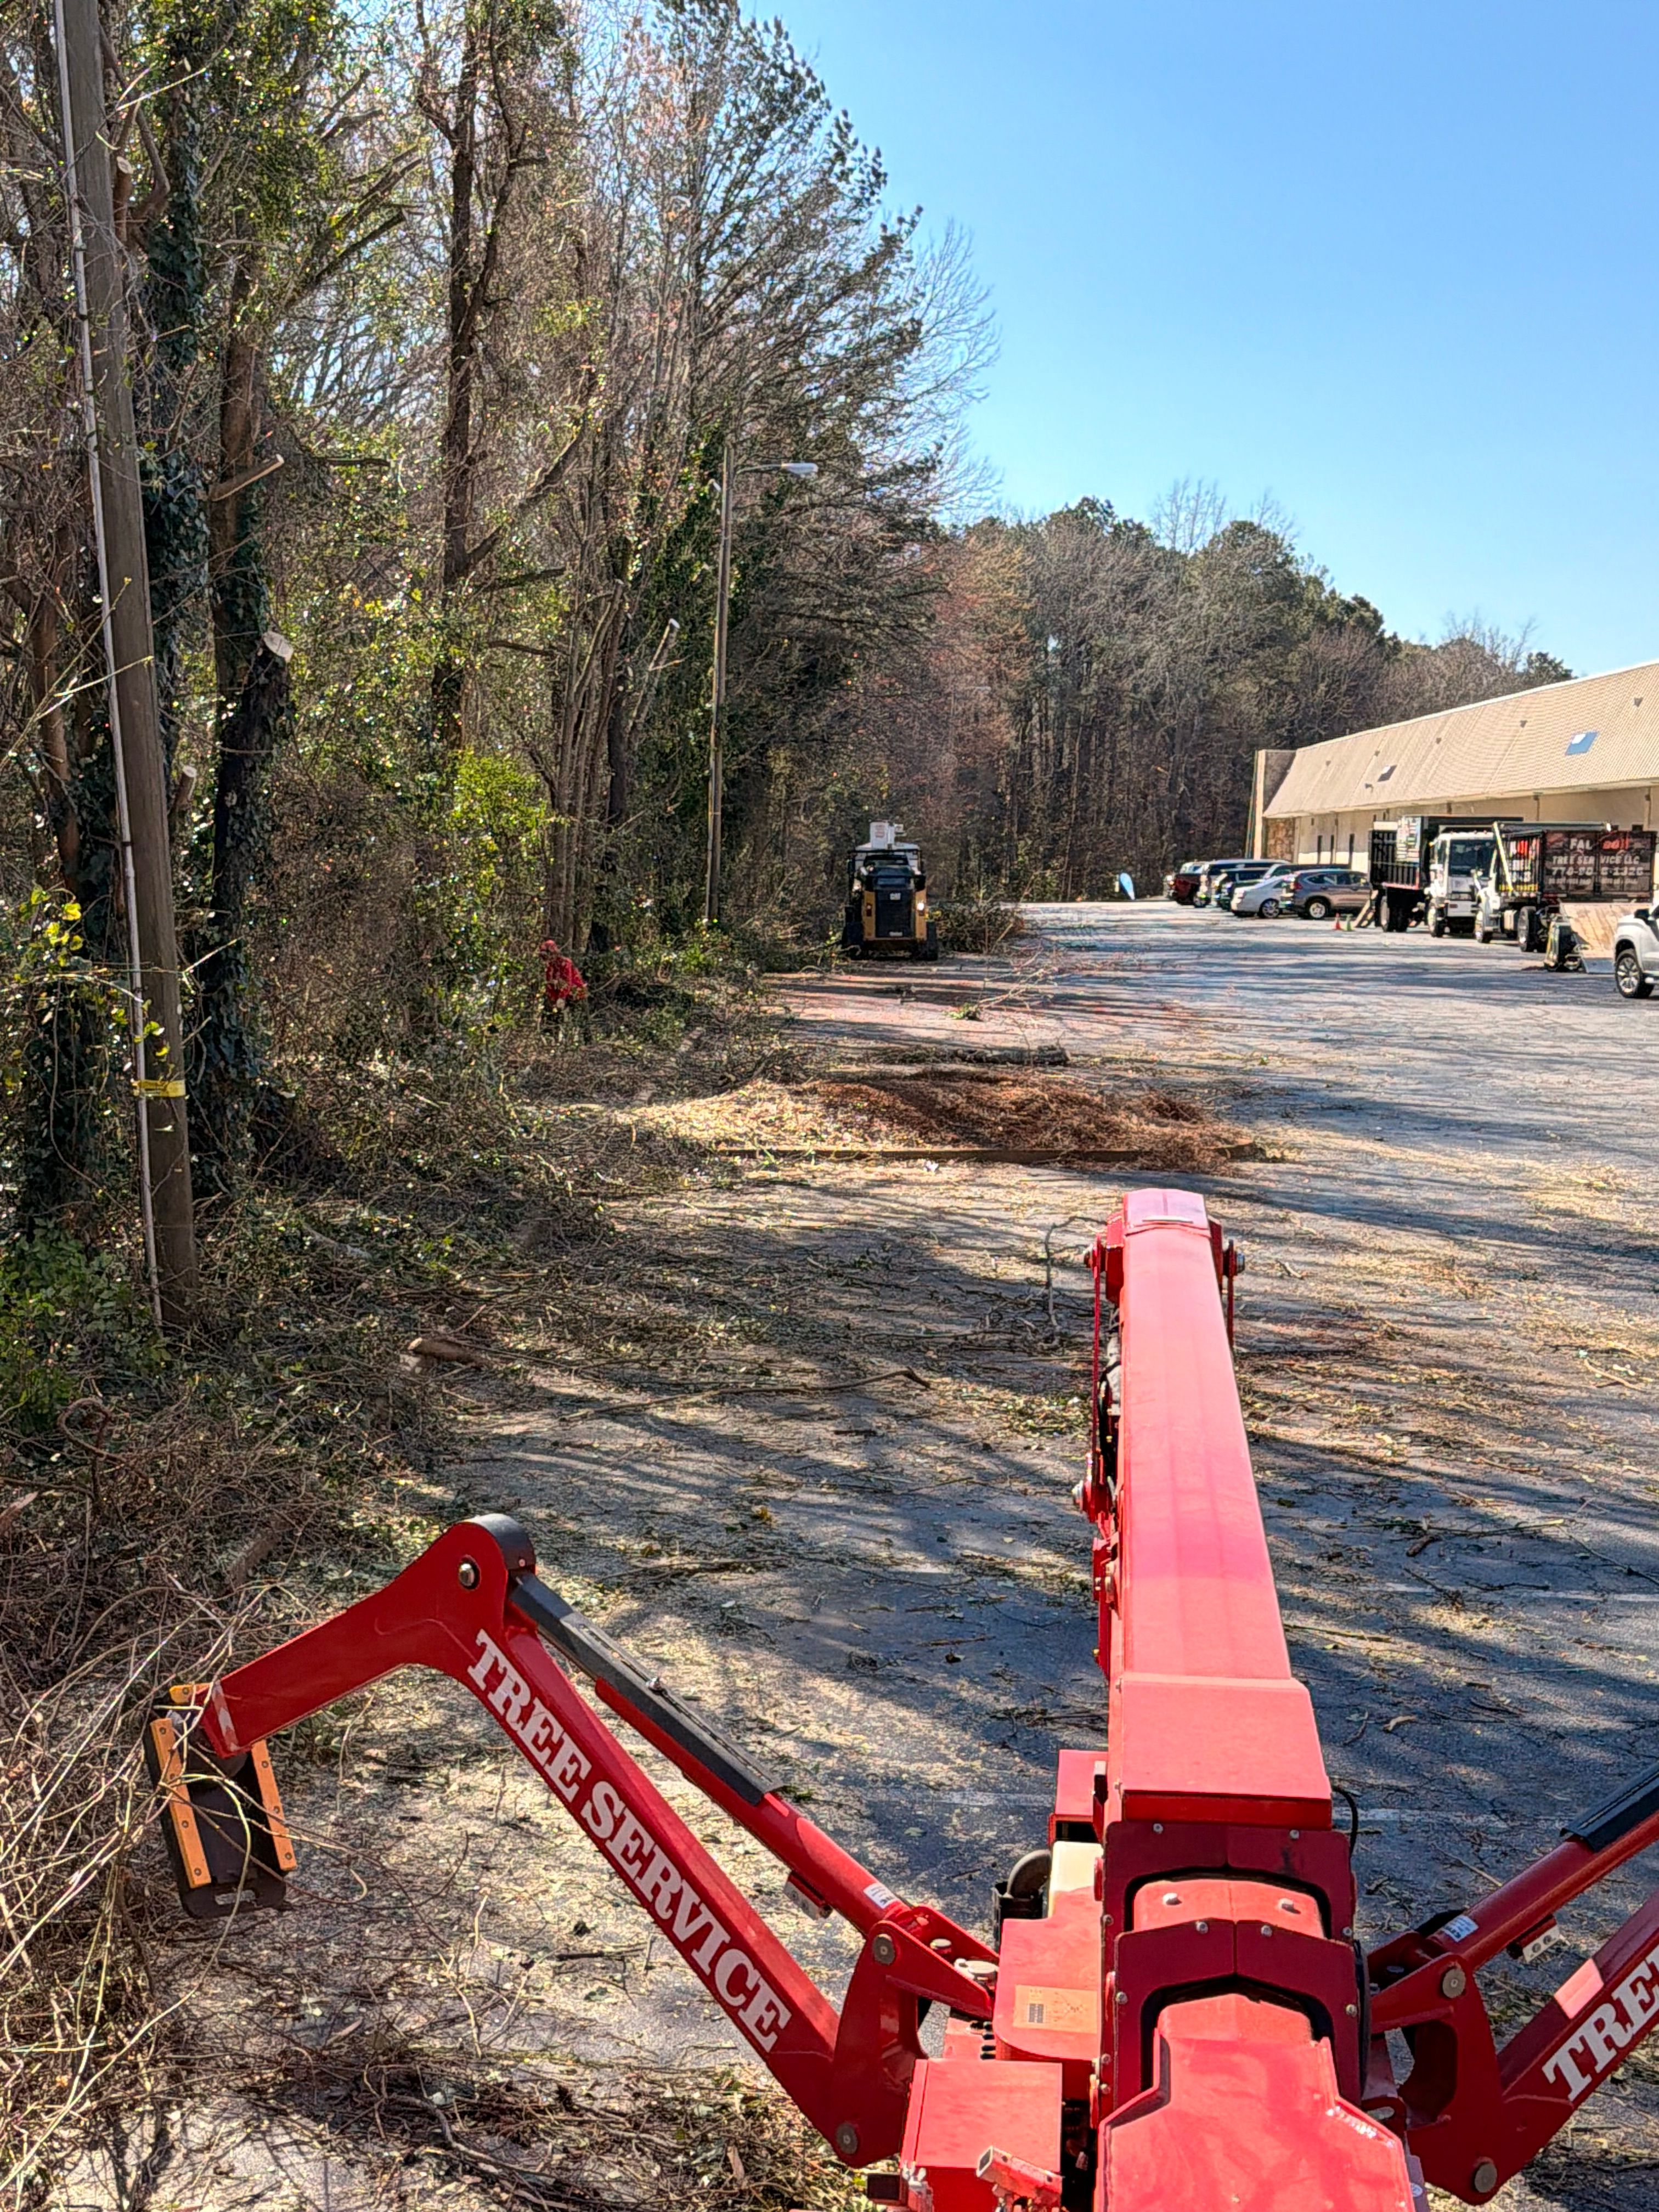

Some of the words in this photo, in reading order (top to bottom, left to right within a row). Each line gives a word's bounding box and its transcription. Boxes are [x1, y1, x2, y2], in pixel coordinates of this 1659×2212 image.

[1552, 855, 1576, 865] TREE
[467, 1628, 592, 1803] TREE
[582, 1781, 792, 2053] SERVICE
[1542, 1944, 1659, 2102] TRE
